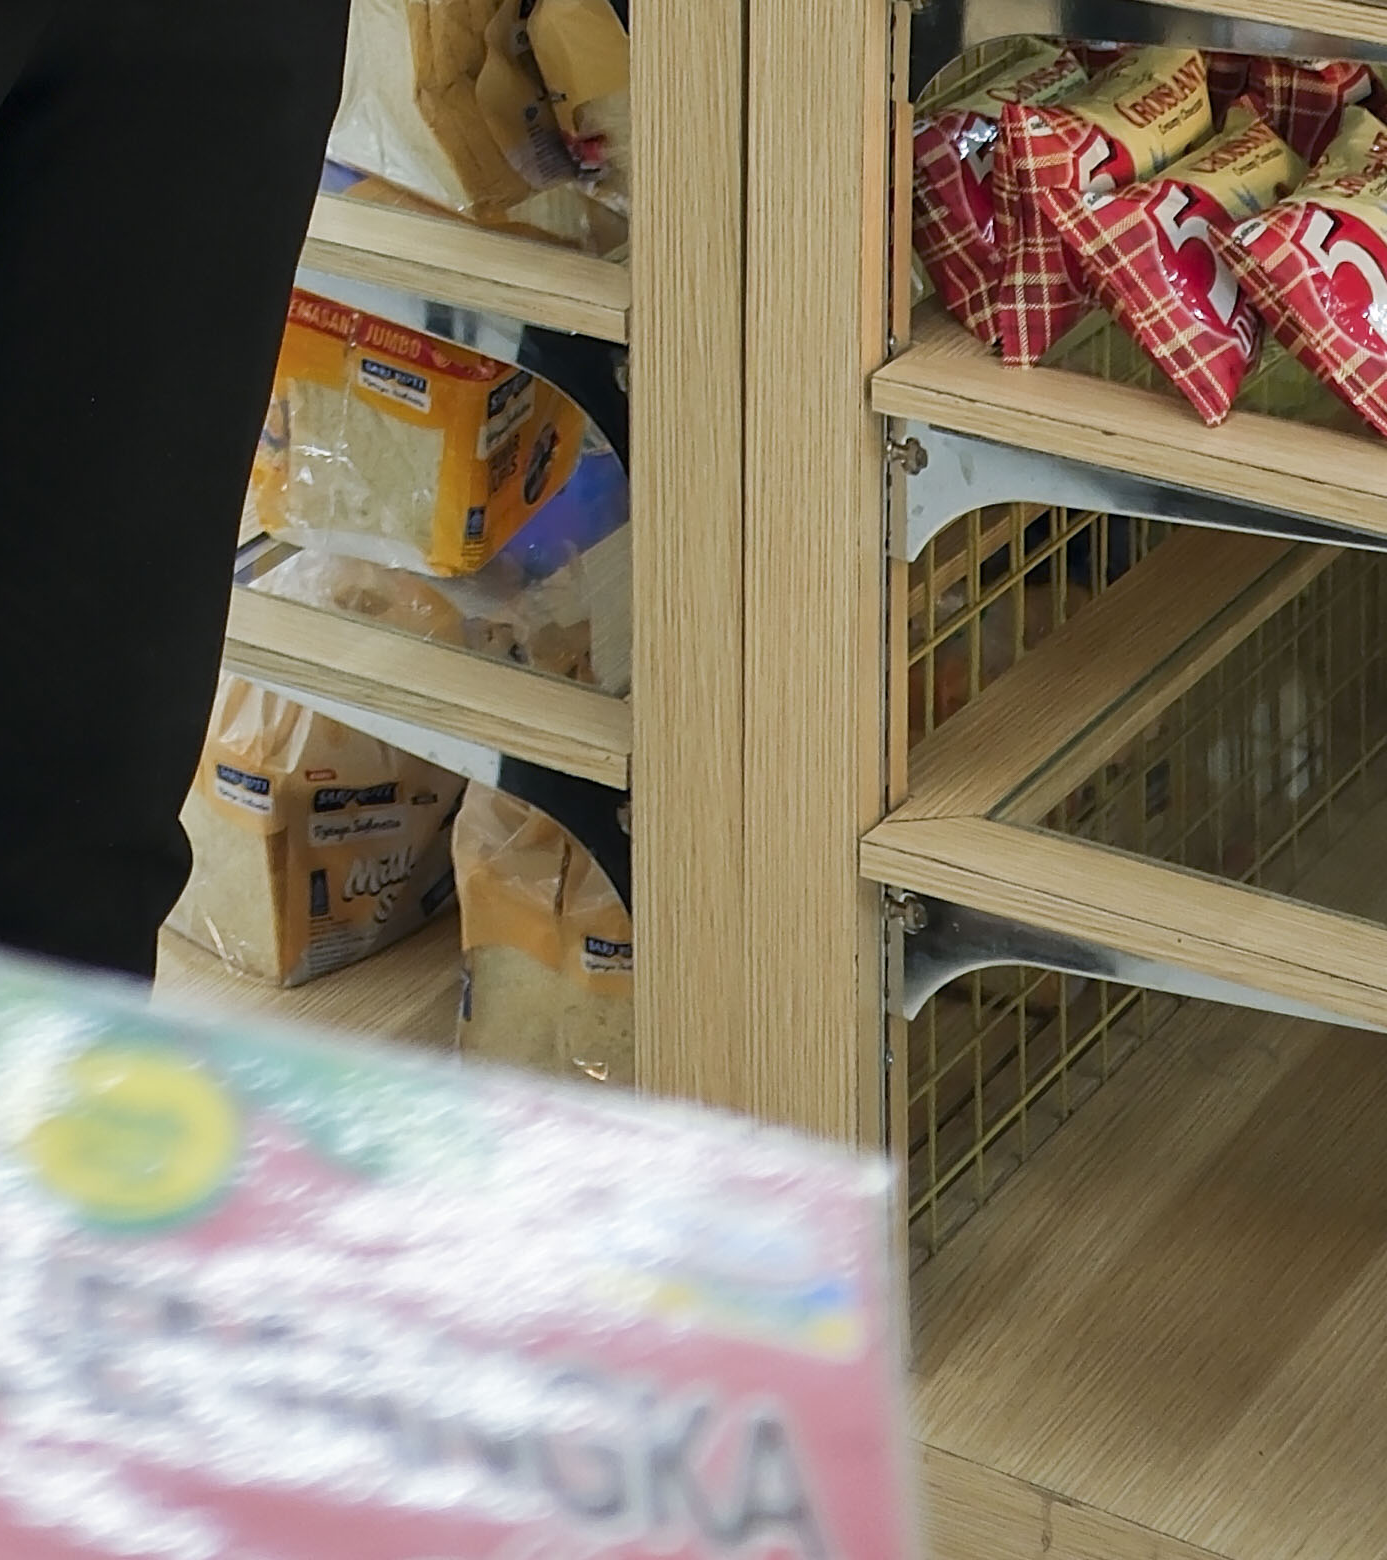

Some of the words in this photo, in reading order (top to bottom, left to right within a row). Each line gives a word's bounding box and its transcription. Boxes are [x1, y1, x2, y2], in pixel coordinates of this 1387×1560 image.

[1152, 183, 1241, 326] 5
[290, 296, 357, 334] EMASAN
[365, 319, 422, 360] JUMBO
